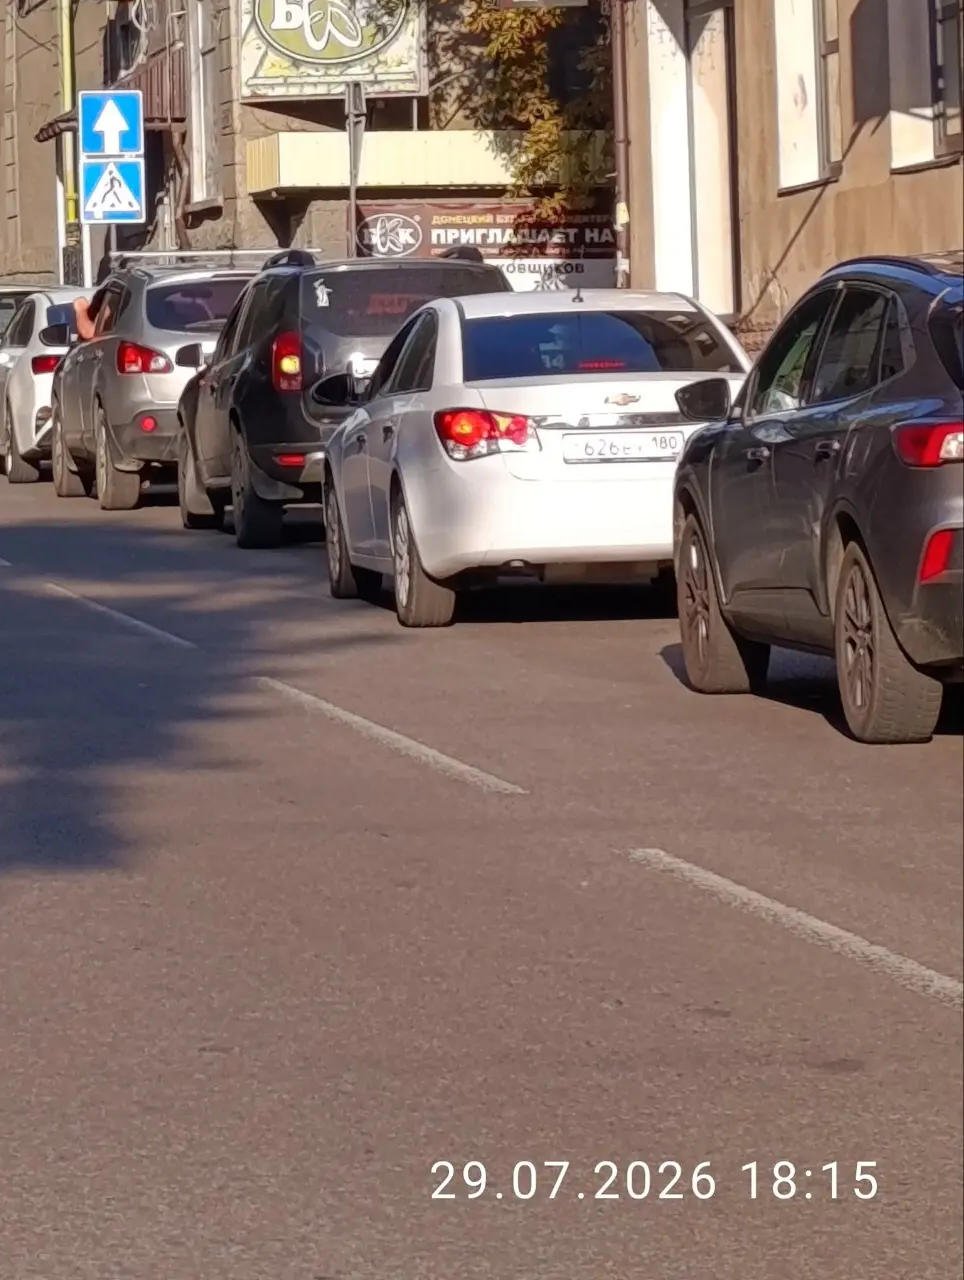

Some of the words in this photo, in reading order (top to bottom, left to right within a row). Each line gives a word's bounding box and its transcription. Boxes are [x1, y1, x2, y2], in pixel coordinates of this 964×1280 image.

[432, 214, 493, 225] ДОНЕЦКИЙ
[431, 228, 579, 245] ПРИГЛАШАЕТ
[585, 228, 615, 243] НА
